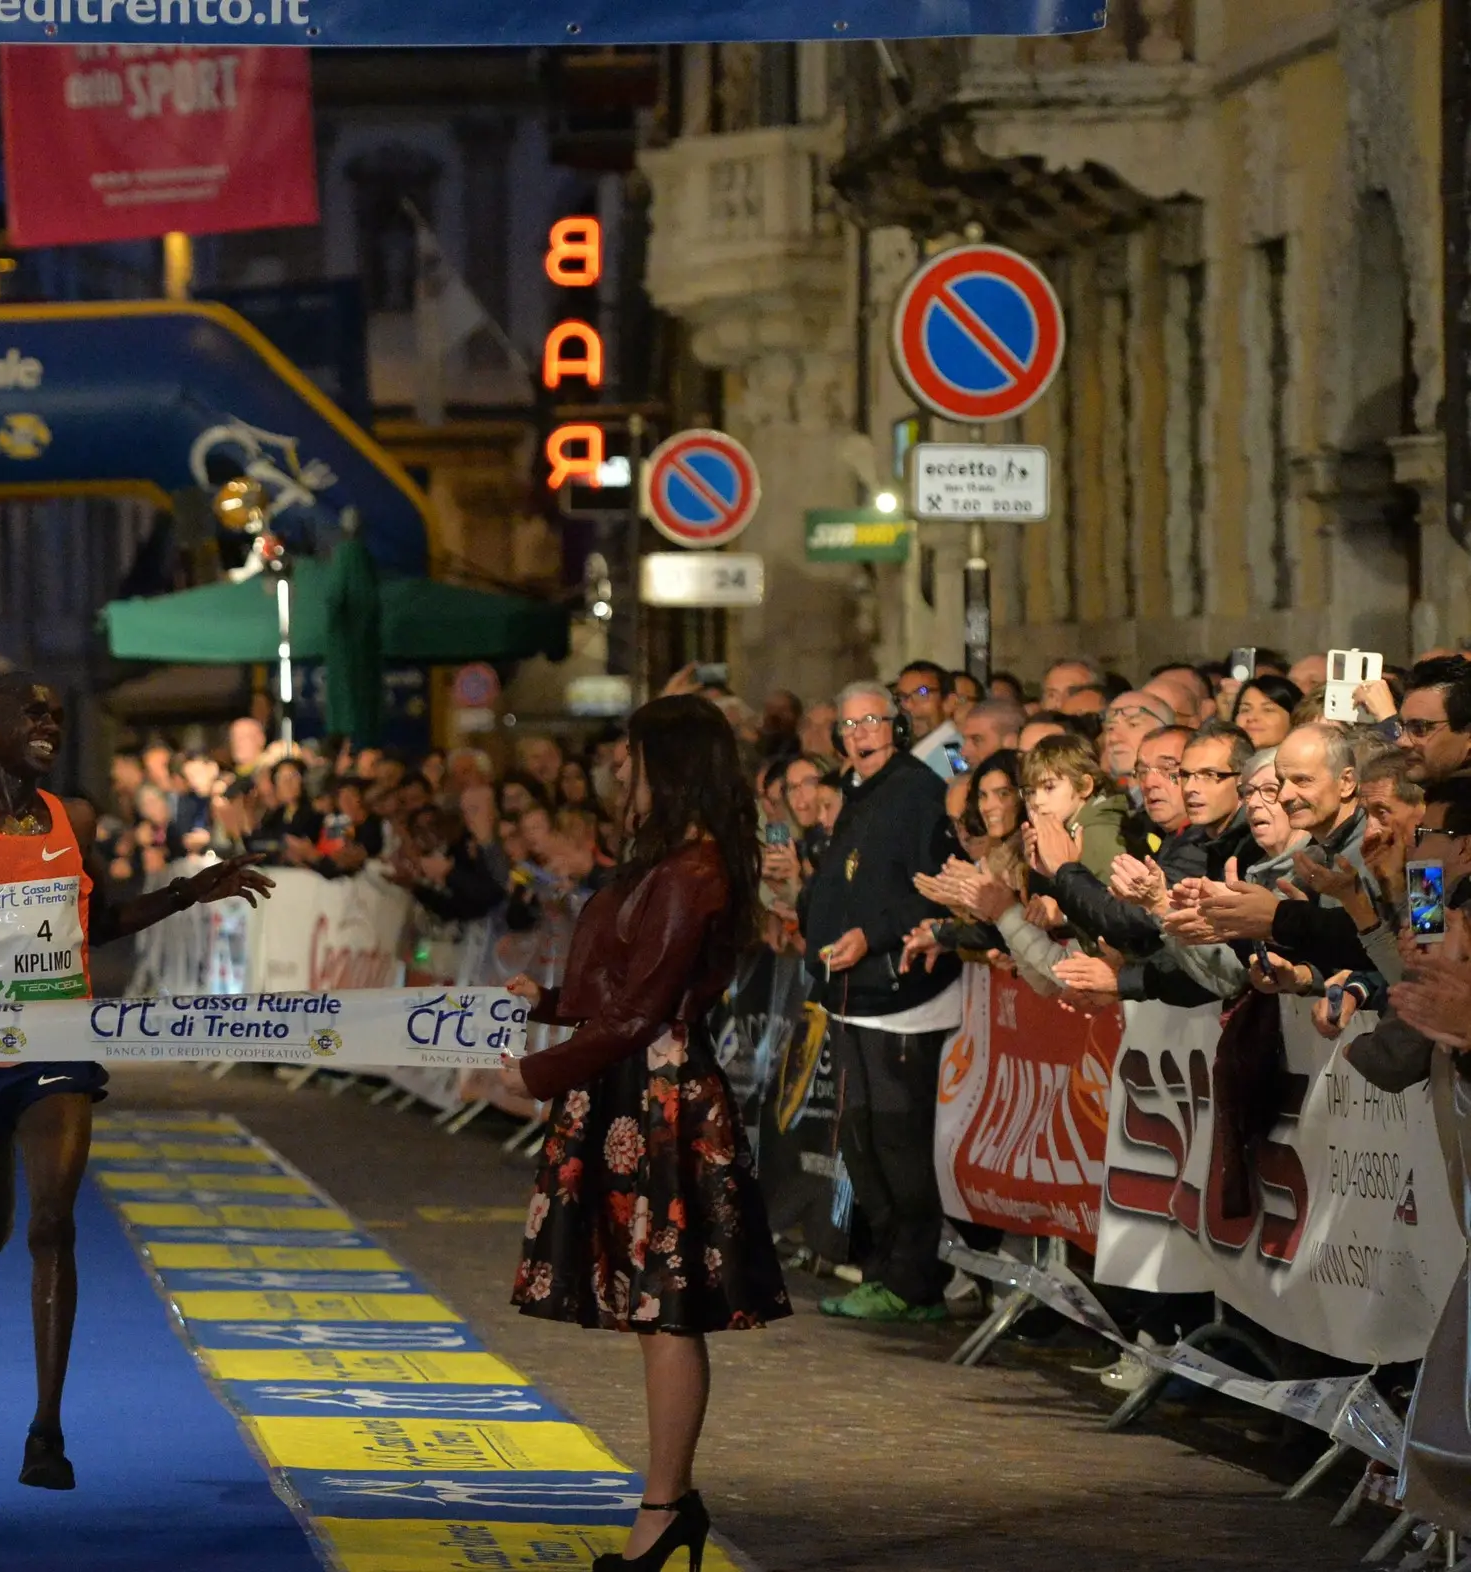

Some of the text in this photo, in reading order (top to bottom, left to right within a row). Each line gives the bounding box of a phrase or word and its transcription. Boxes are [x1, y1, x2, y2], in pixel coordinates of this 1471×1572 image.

[125, 57, 238, 118] SPORT
[925, 460, 997, 478] eccetto
[21, 885, 51, 896] Cassa
[23, 894, 67, 906] di Trento
[36, 919, 53, 942] 4
[14, 949, 72, 974] KIPLIMO
[171, 993, 342, 1015] Cassa Rurale
[170, 1014, 290, 1039] di Trento
[486, 1026, 512, 1049] di
[106, 1045, 312, 1060] BANCA DI CREDITO COOPERATIVO
